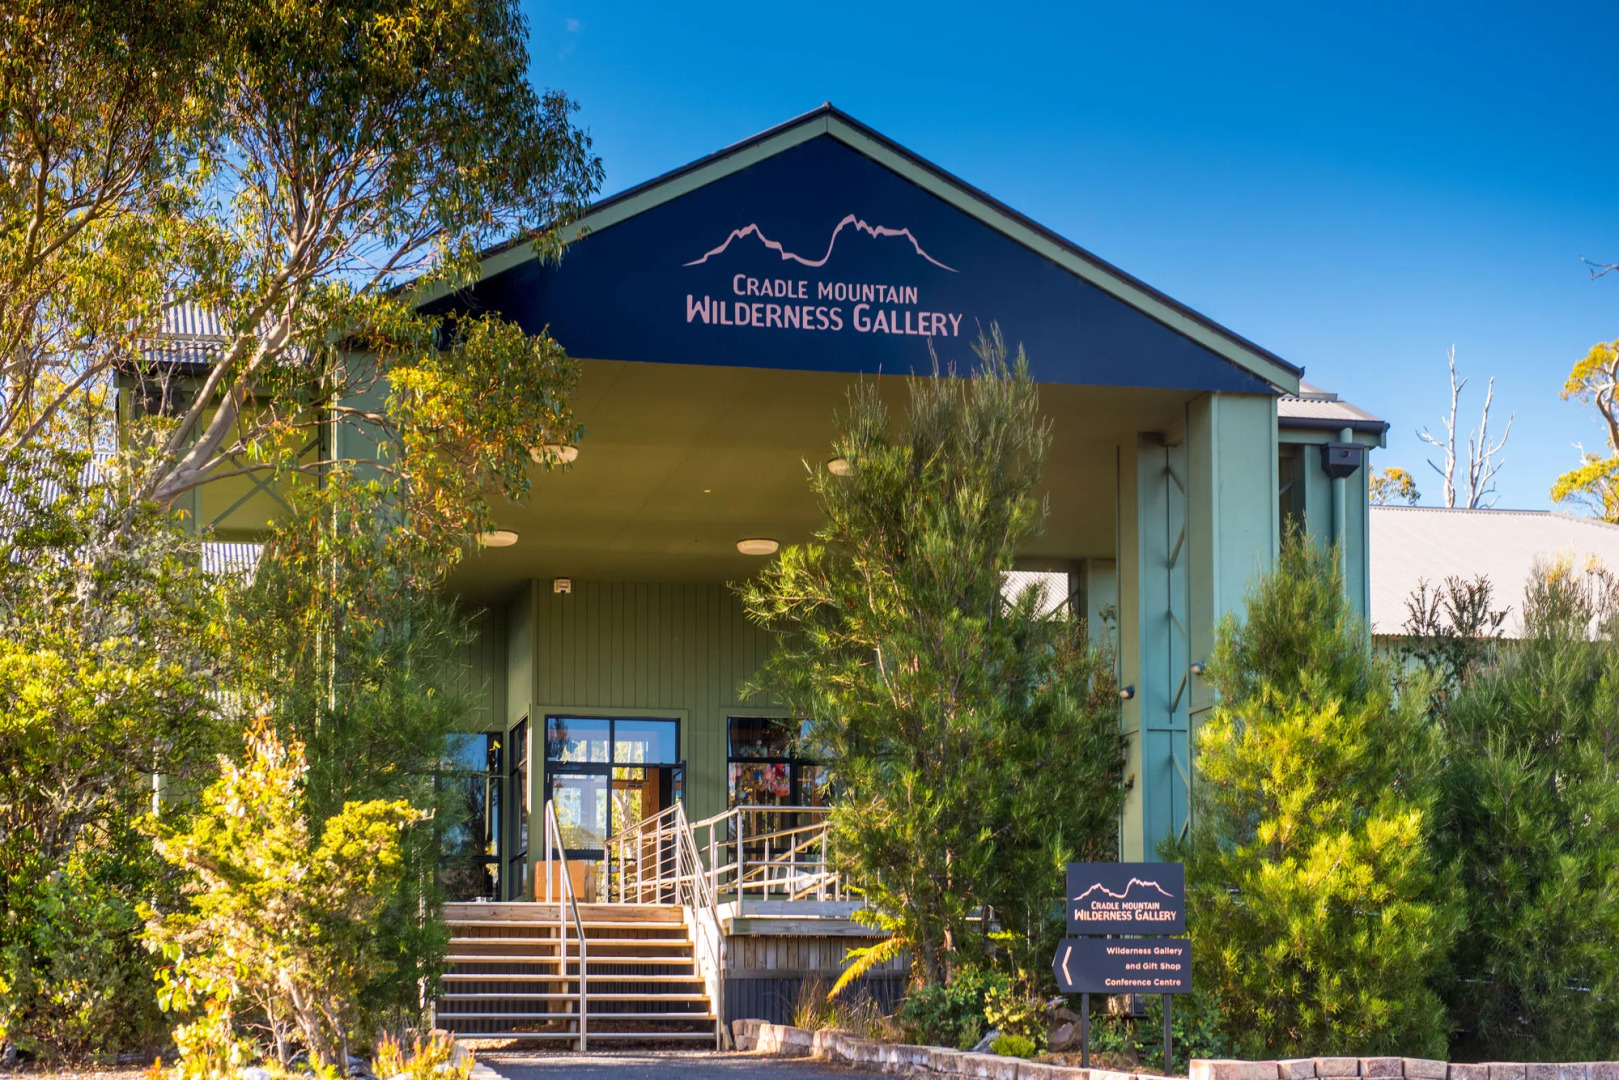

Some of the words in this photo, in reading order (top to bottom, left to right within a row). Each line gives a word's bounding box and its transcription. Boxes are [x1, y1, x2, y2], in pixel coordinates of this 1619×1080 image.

[733, 273, 808, 299] CRADLE
[818, 281, 918, 305] MOUNTAIN
[686, 294, 843, 331] WILDERNESS
[853, 303, 963, 337] GALLERY
[1091, 901, 1119, 910] CRADLE
[1122, 902, 1160, 910] MOUNTAIN
[1074, 909, 1132, 921] WILDERNESS
[1135, 909, 1176, 921] GALLERY
[1106, 947, 1151, 955] Wilderness
[1153, 947, 1182, 955] Gallery
[1125, 962, 1141, 970] and
[1142, 962, 1158, 970] Gift
[1160, 962, 1181, 971] Shop
[1105, 978, 1151, 986] Conference
[1153, 978, 1181, 986] Centre
